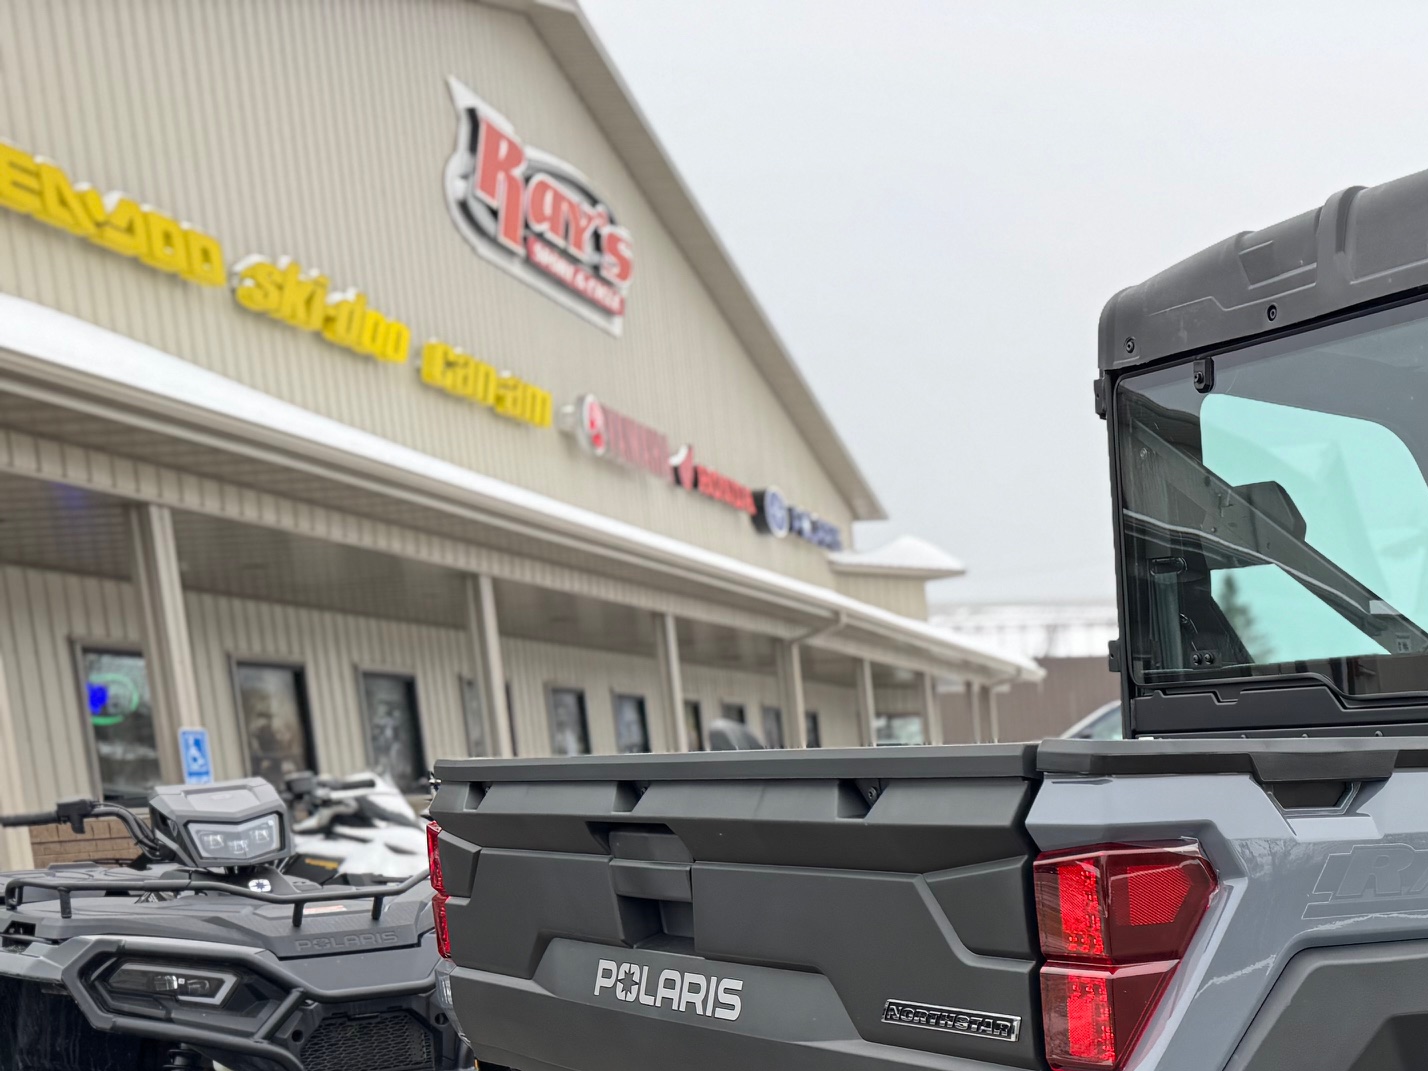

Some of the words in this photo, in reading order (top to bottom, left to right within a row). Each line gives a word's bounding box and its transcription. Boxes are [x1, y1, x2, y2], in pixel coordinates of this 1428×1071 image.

[474, 116, 636, 286] Ray's
[295, 931, 399, 952] POLARIS
[594, 958, 744, 1021] POLARIS
[886, 1004, 1012, 1037] NORTHSTAR
